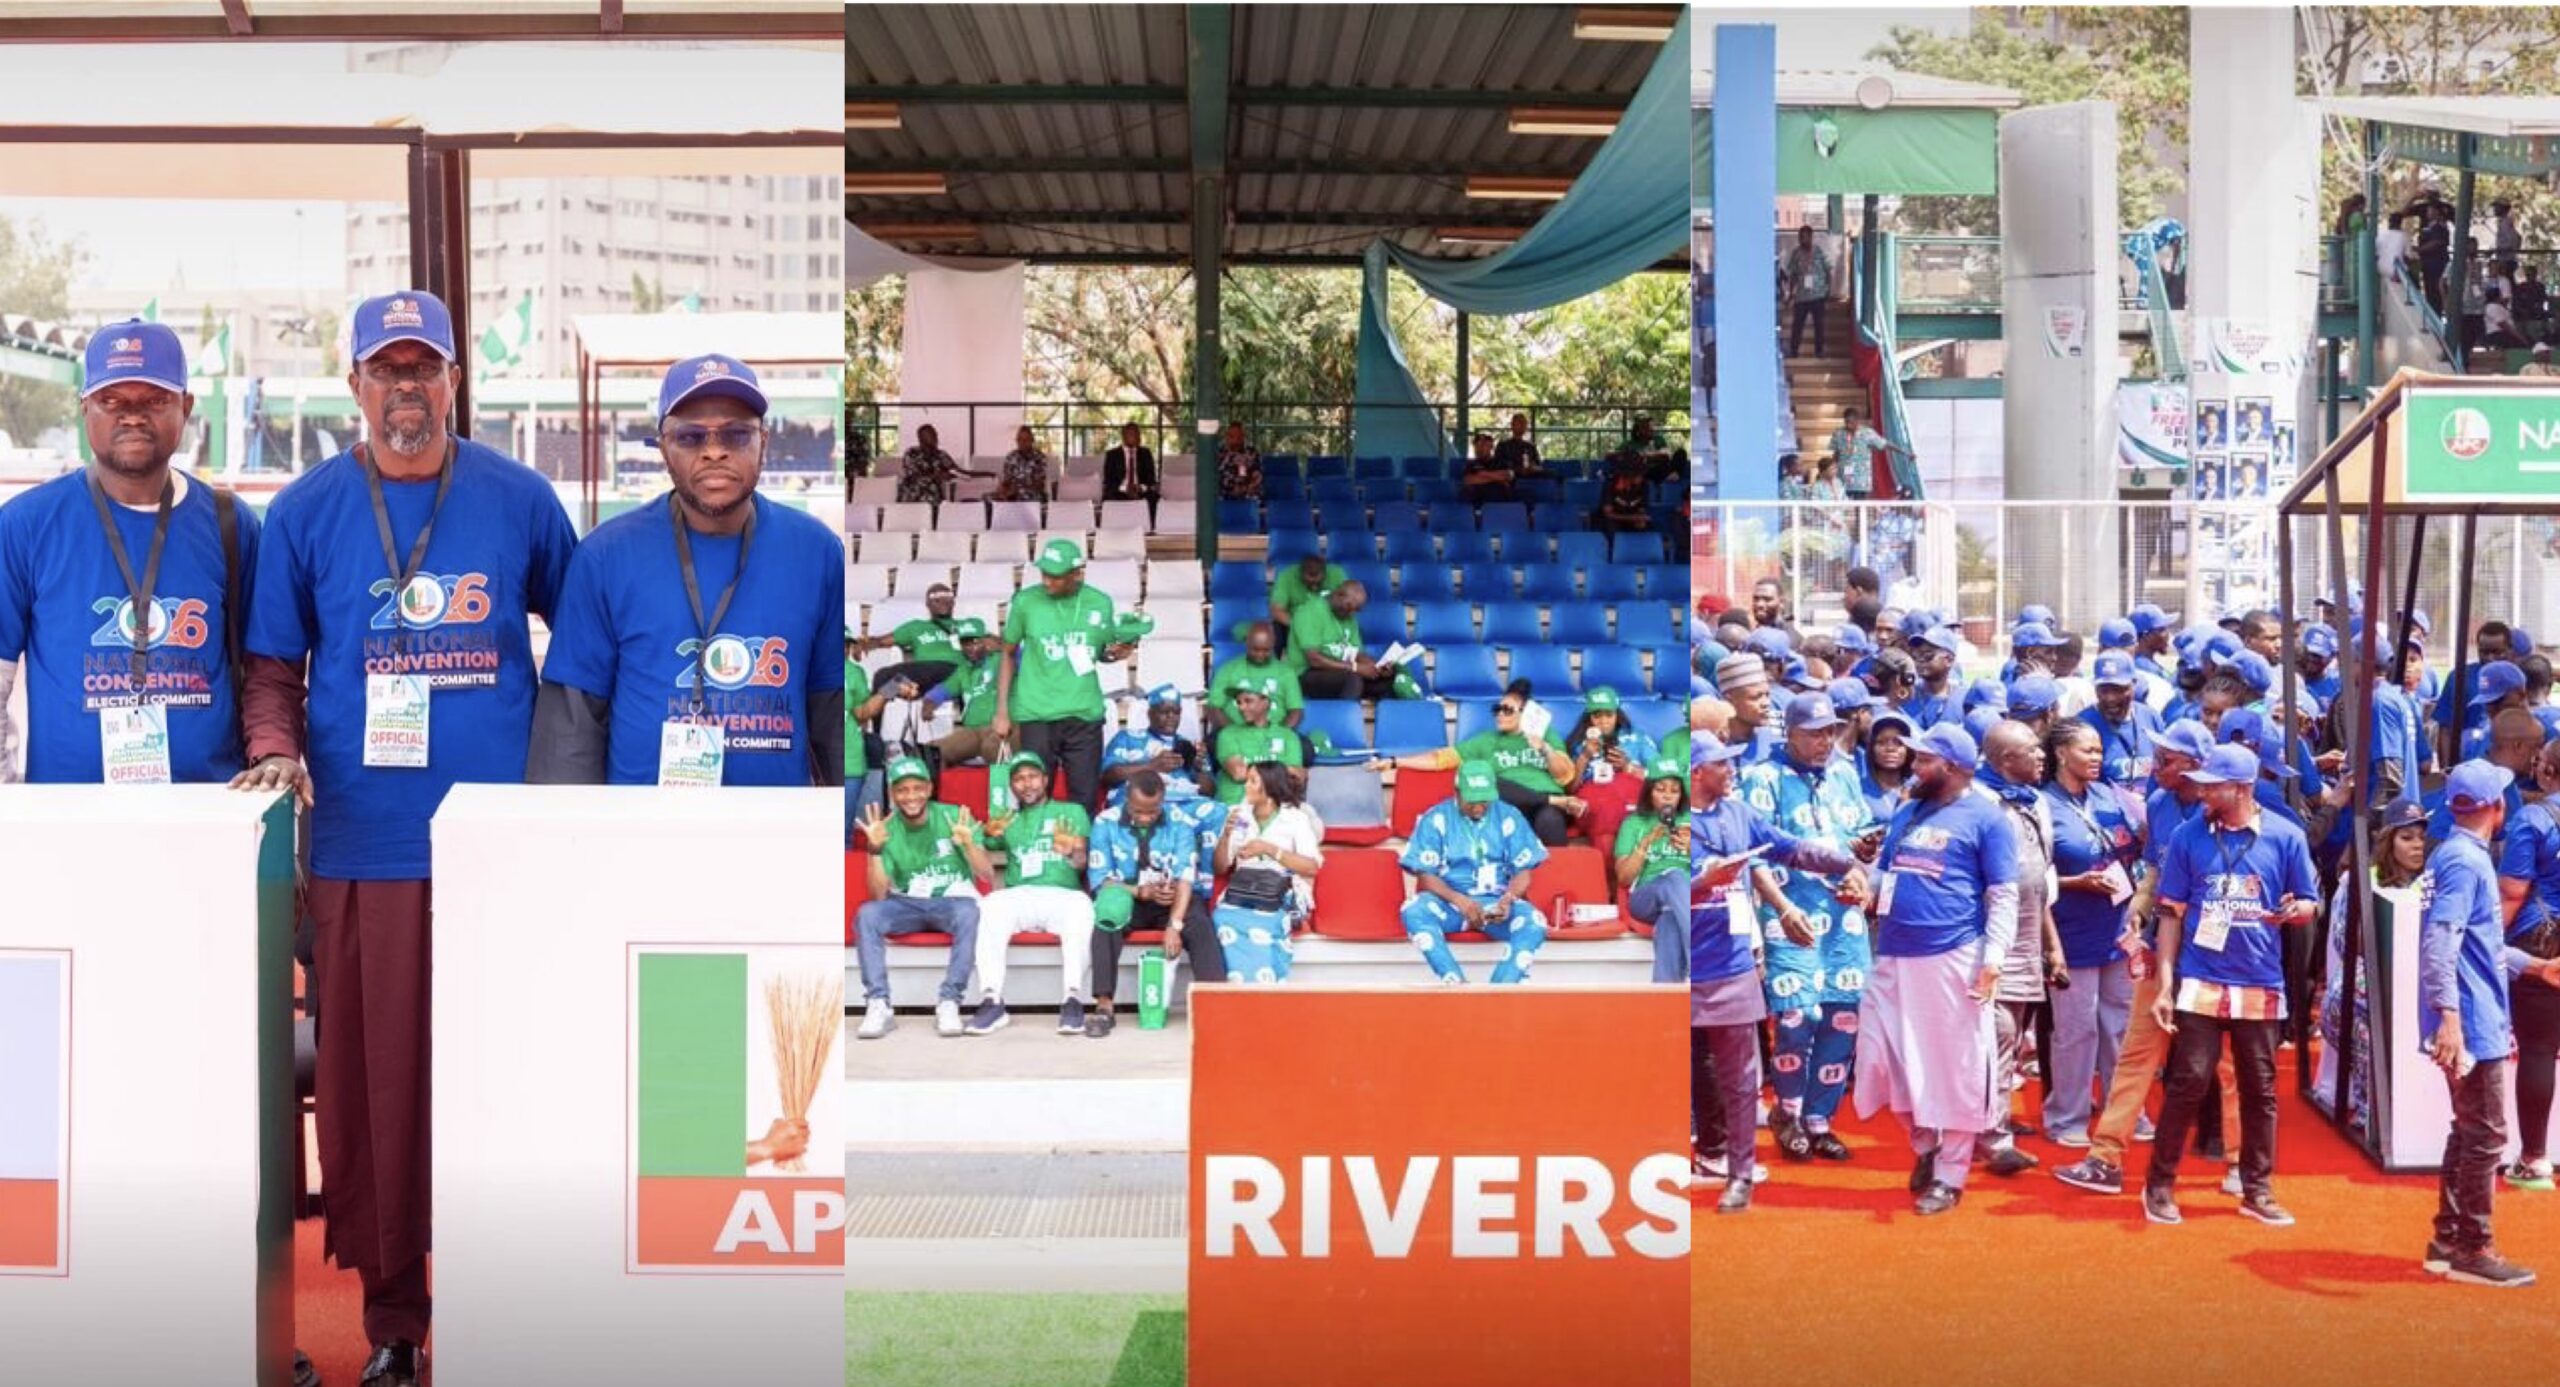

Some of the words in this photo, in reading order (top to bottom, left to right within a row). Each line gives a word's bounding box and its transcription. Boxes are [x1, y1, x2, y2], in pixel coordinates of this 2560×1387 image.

[365, 651, 498, 674] CONVENTION
[83, 672, 210, 691] CONENTION
[429, 674, 496, 686] COMMITTEE
[370, 731, 424, 745] OFFICIAL
[111, 765, 167, 780] OFFICIAL
[1206, 1153, 1691, 1259] RIVERS
[713, 1189, 845, 1253] AP
